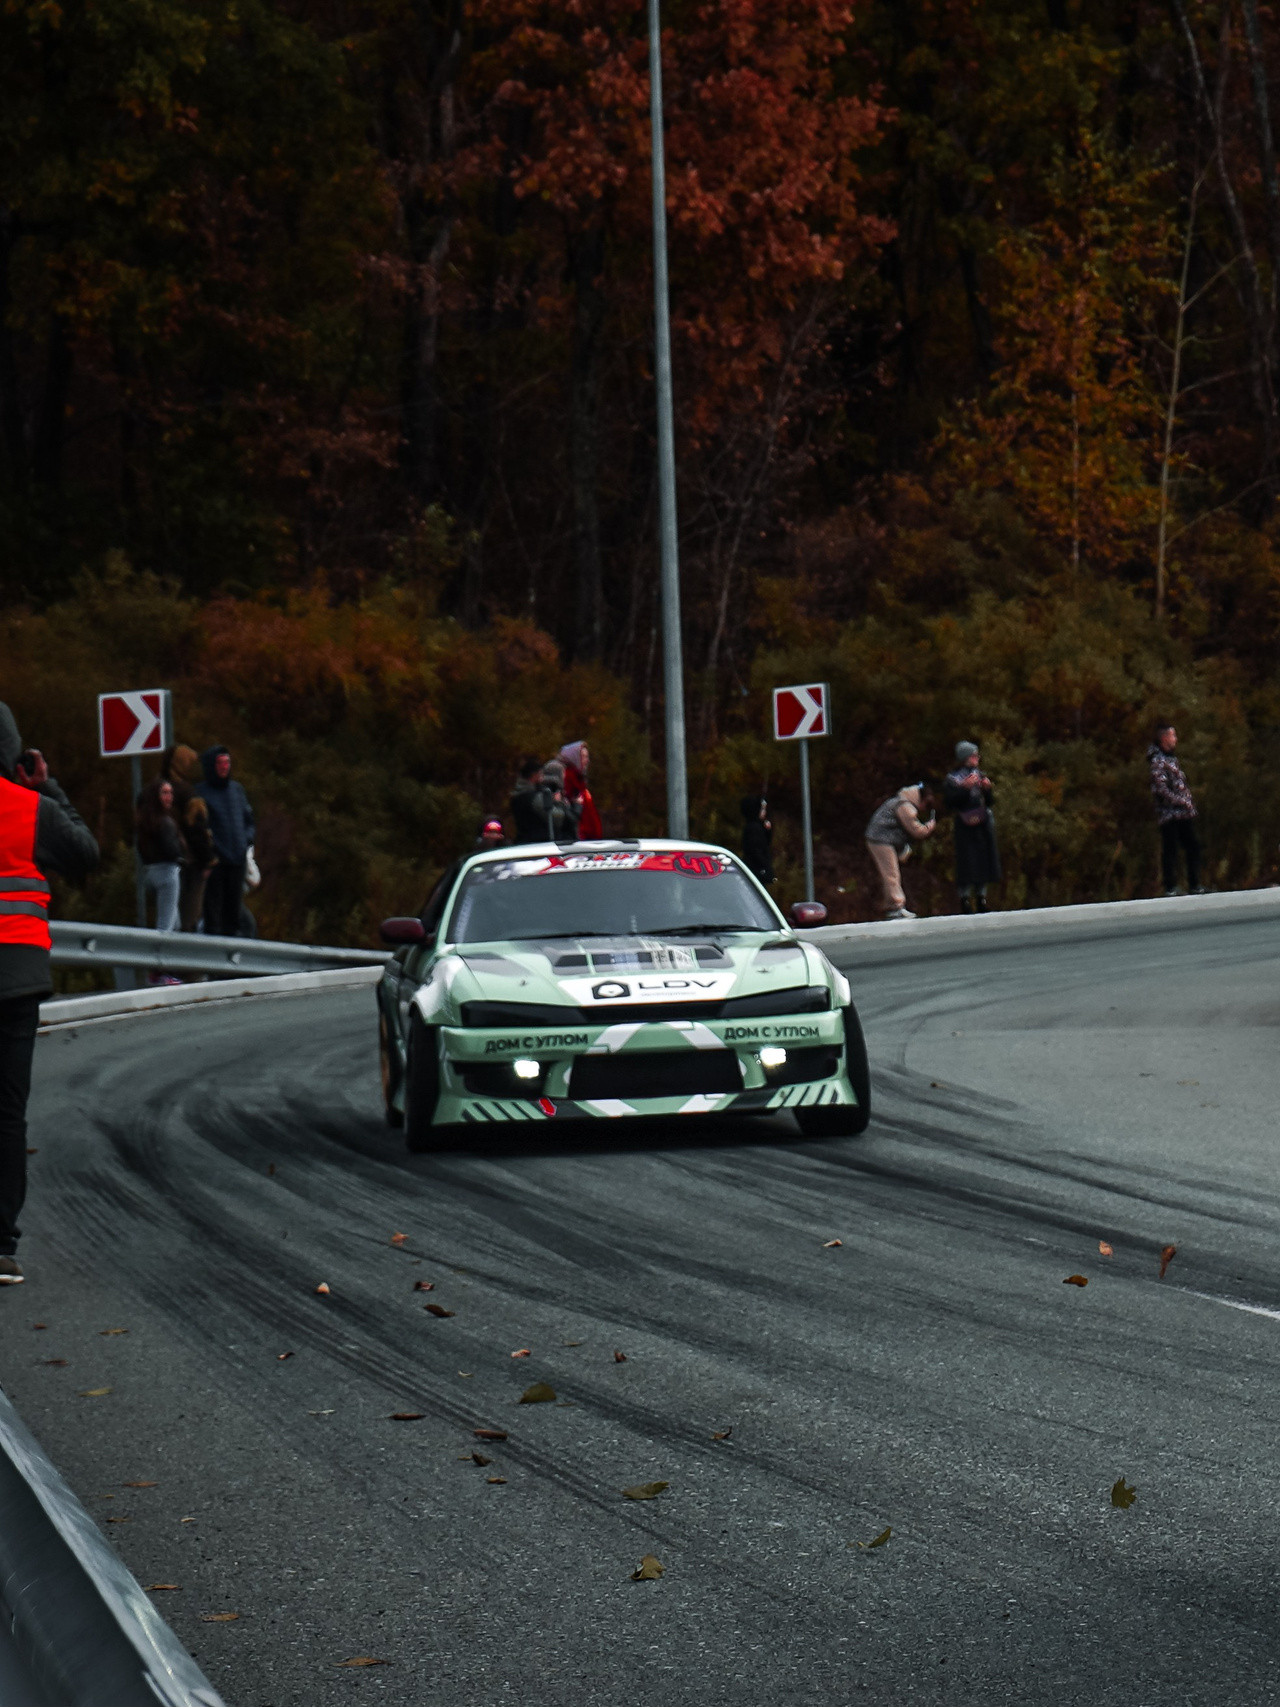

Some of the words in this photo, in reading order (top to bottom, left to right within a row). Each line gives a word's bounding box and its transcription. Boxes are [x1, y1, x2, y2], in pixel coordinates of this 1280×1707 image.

[638, 980, 718, 990] LDV
[724, 1027, 759, 1040] ДОМ
[761, 1026, 772, 1037] С
[485, 1038, 520, 1053] ДОМ
[522, 1036, 534, 1049] С
